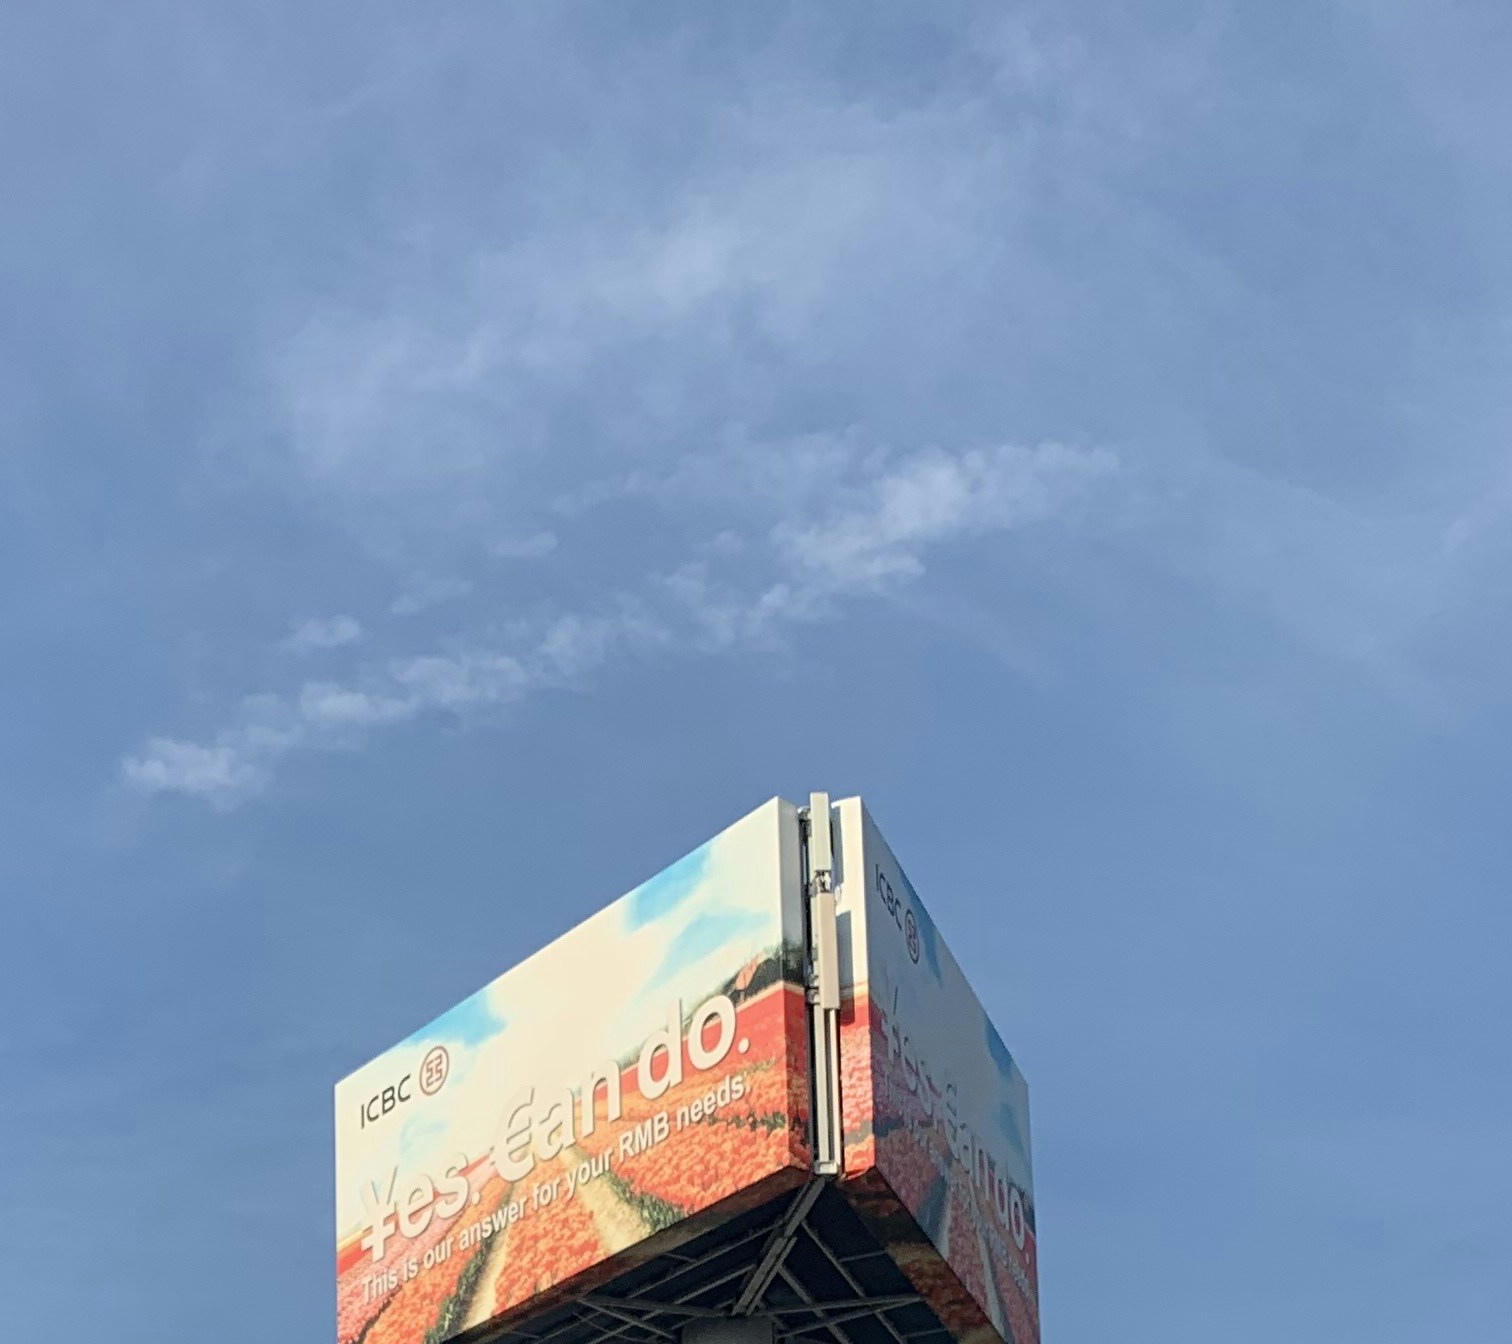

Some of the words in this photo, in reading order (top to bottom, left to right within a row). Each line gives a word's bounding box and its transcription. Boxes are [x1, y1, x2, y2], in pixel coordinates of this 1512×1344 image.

[875, 863, 903, 932] ICBC
[638, 994, 750, 1100] do.
[360, 1073, 411, 1129] ICBC
[361, 1268, 399, 1305] This
[402, 1256, 419, 1283] is
[423, 1239, 455, 1268] our
[459, 1198, 529, 1251] answer
[533, 1179, 561, 1212] for
[568, 1146, 615, 1199] your
[619, 1110, 670, 1163] RMB
